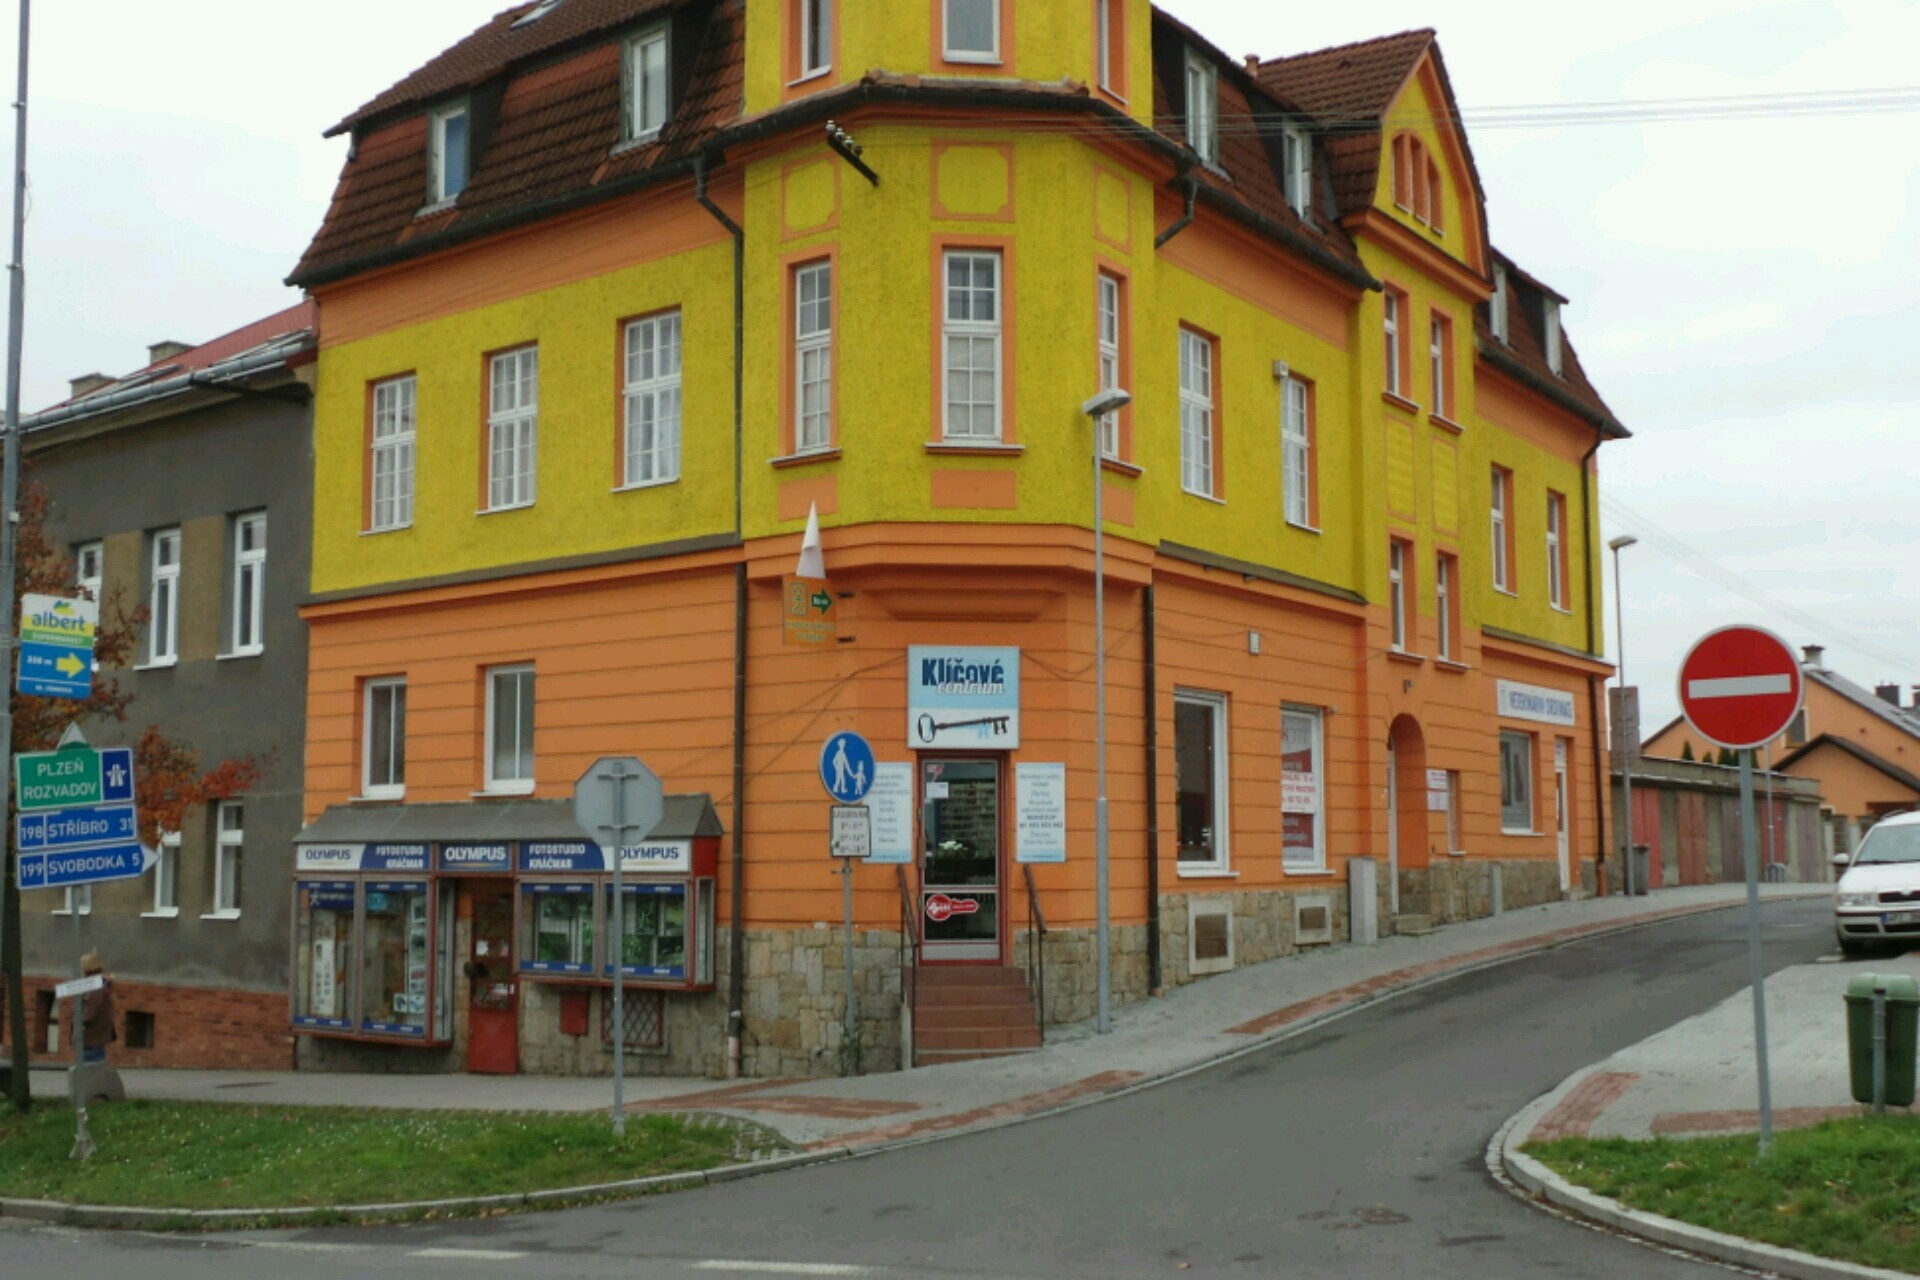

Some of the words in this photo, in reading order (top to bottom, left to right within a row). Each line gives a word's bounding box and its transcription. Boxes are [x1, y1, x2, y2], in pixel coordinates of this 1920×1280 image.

[32, 611, 85, 632] albert
[922, 658, 1005, 686] Klíčové
[937, 680, 1006, 695] centrum
[37, 758, 84, 776] PLZEŇ
[23, 782, 97, 800] ROZVADOV
[21, 825, 44, 840] 198
[48, 818, 109, 838] STŘÍBRO
[305, 848, 351, 861] OLYMPUS
[375, 844, 424, 856] FOTOSTUDIO
[445, 846, 506, 861] OLYMPUS
[528, 843, 586, 855] FOTOSTUDIO
[21, 862, 44, 879] 199
[48, 855, 125, 876] SVOBODKA
[132, 852, 140, 866] 5
